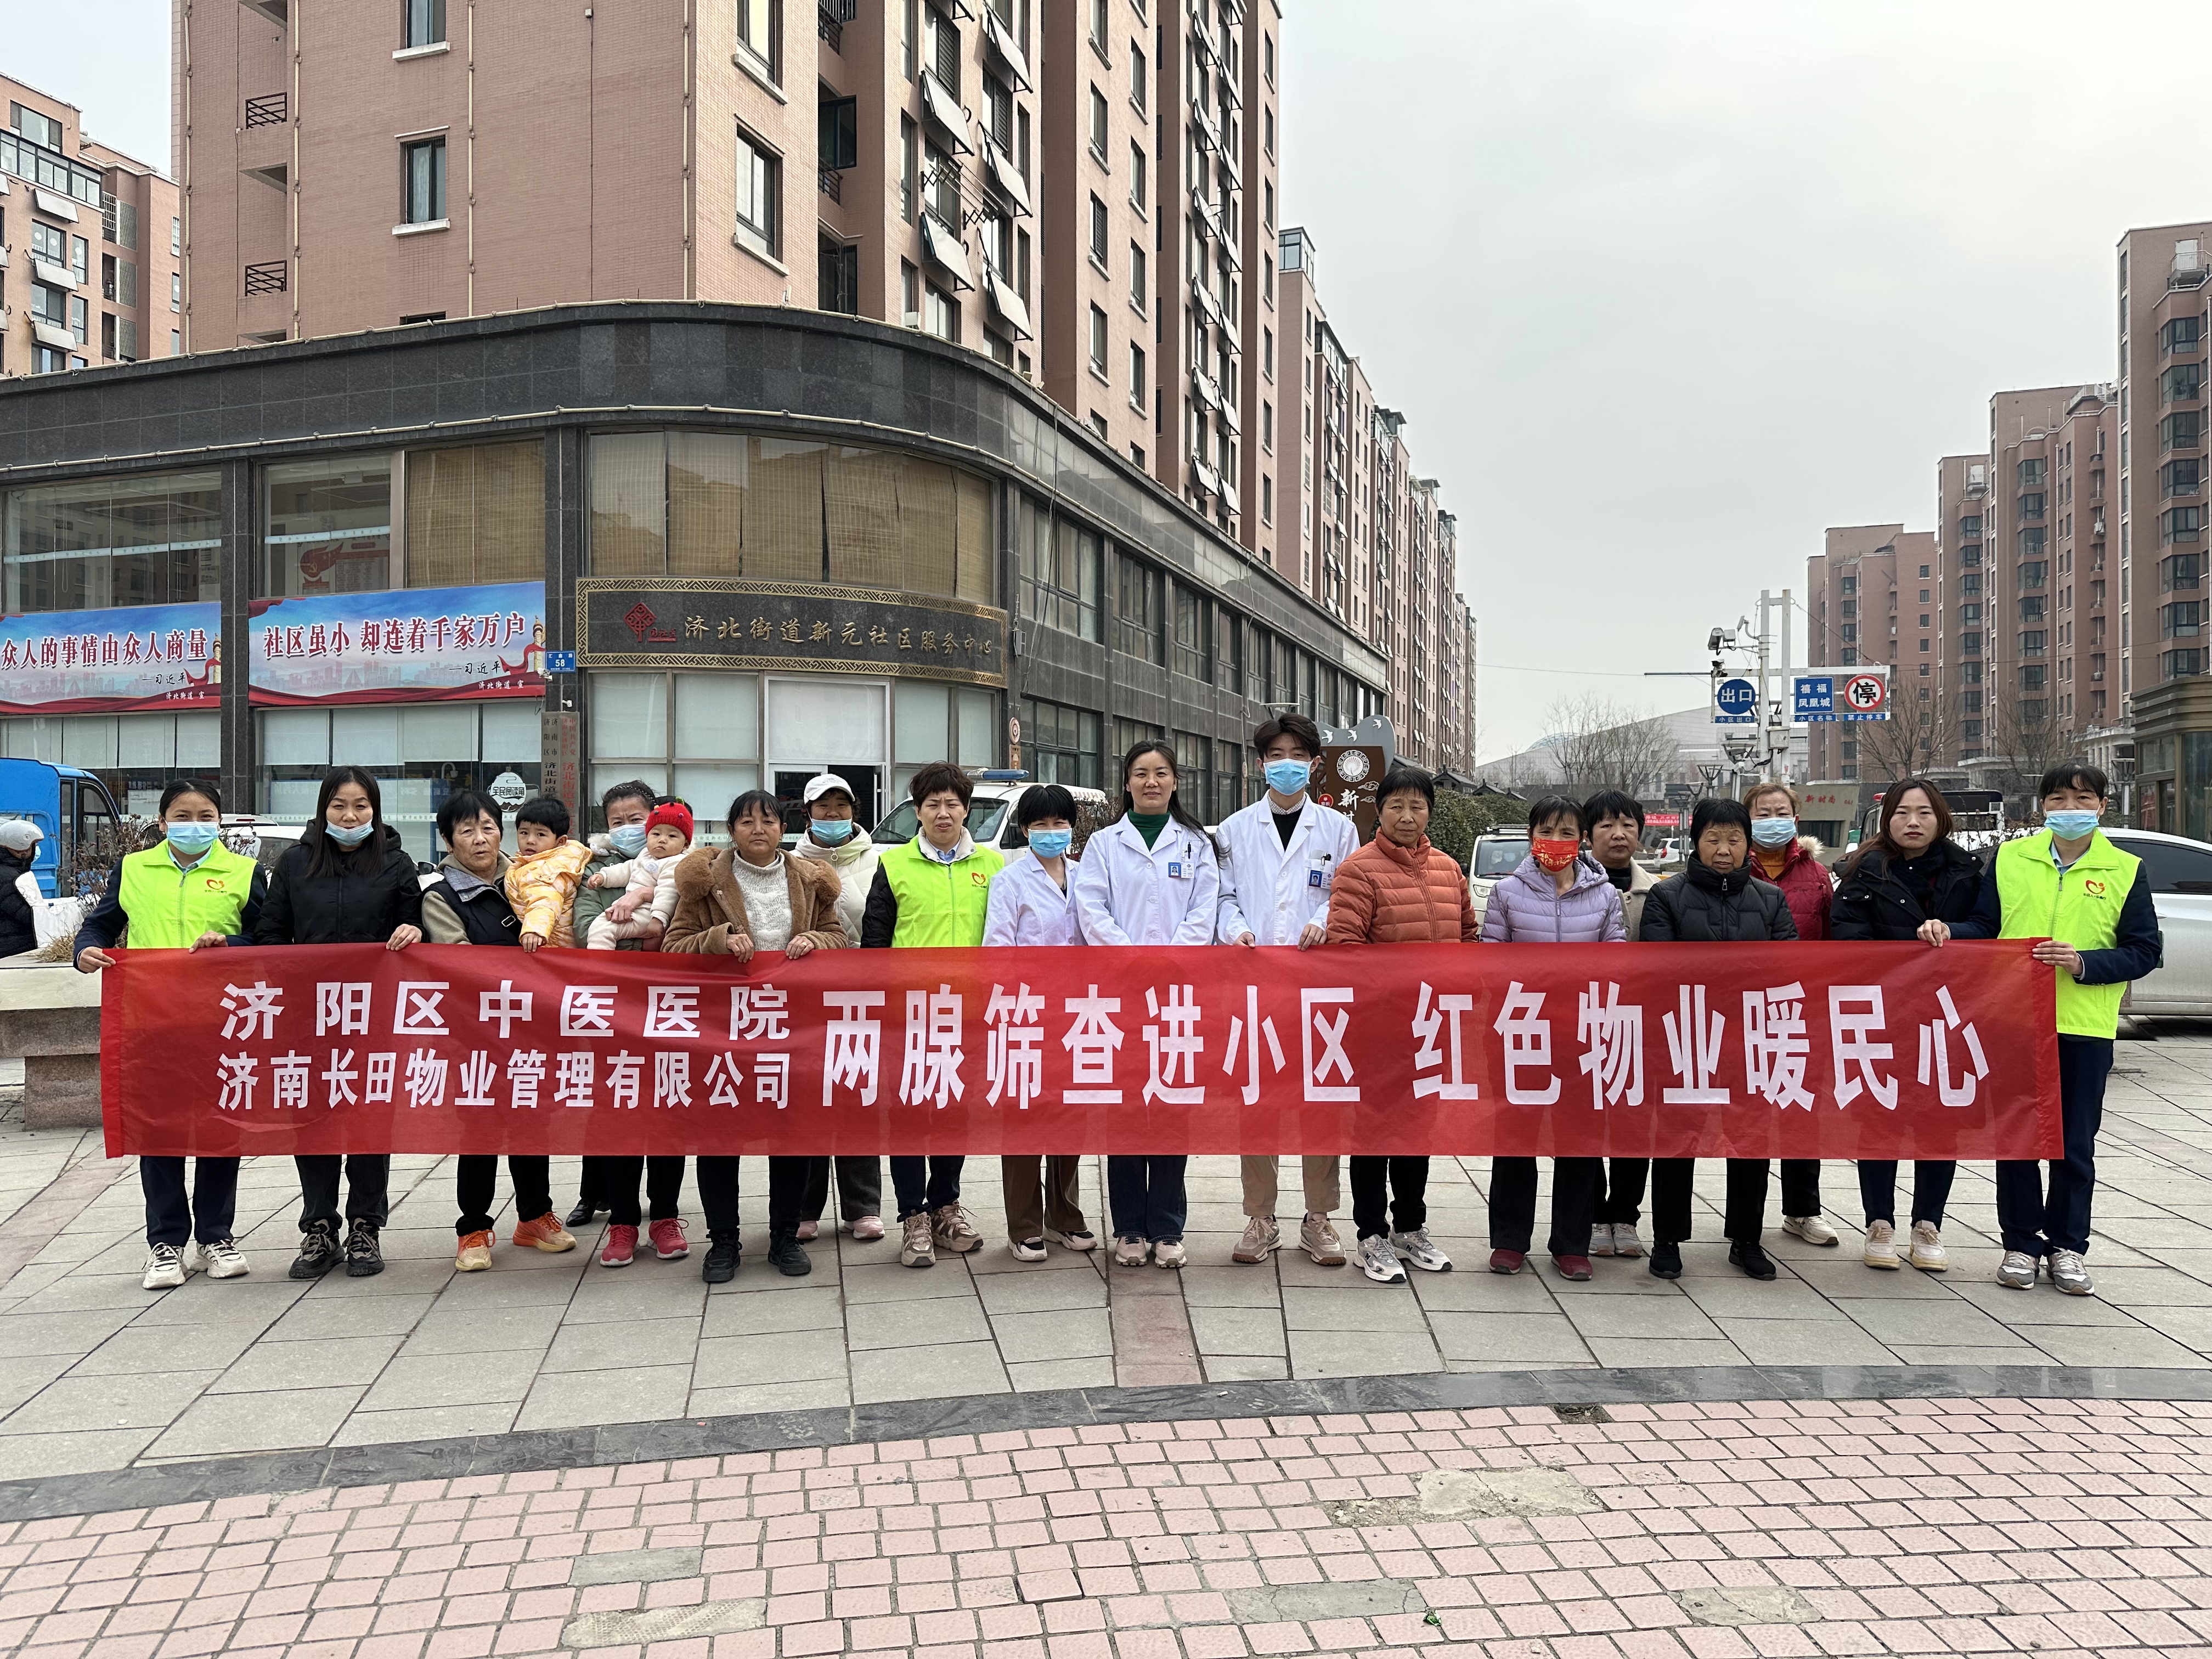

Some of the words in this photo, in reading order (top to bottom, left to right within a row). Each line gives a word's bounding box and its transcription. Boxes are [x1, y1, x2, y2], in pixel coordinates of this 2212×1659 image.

[2, 629, 207, 669] 众人的事情由众人商量
[264, 623, 349, 657] 社区虽小
[361, 613, 525, 652] 却连着千家万户
[685, 614, 992, 658] 济北街道新元社区服务中心
[555, 659, 565, 667] 58
[1720, 687, 1752, 703] 出口
[1798, 697, 1831, 708] 凤凰城
[1853, 681, 1876, 704] 停
[493, 786, 524, 796] 全民阅读角
[220, 979, 790, 1041] 济阳区中医医院
[822, 981, 1361, 1110] 两腺筛查进小区
[1411, 980, 1990, 1112] 红色物业暖民心
[217, 1048, 790, 1110] 济南长田物业管理有限公司
